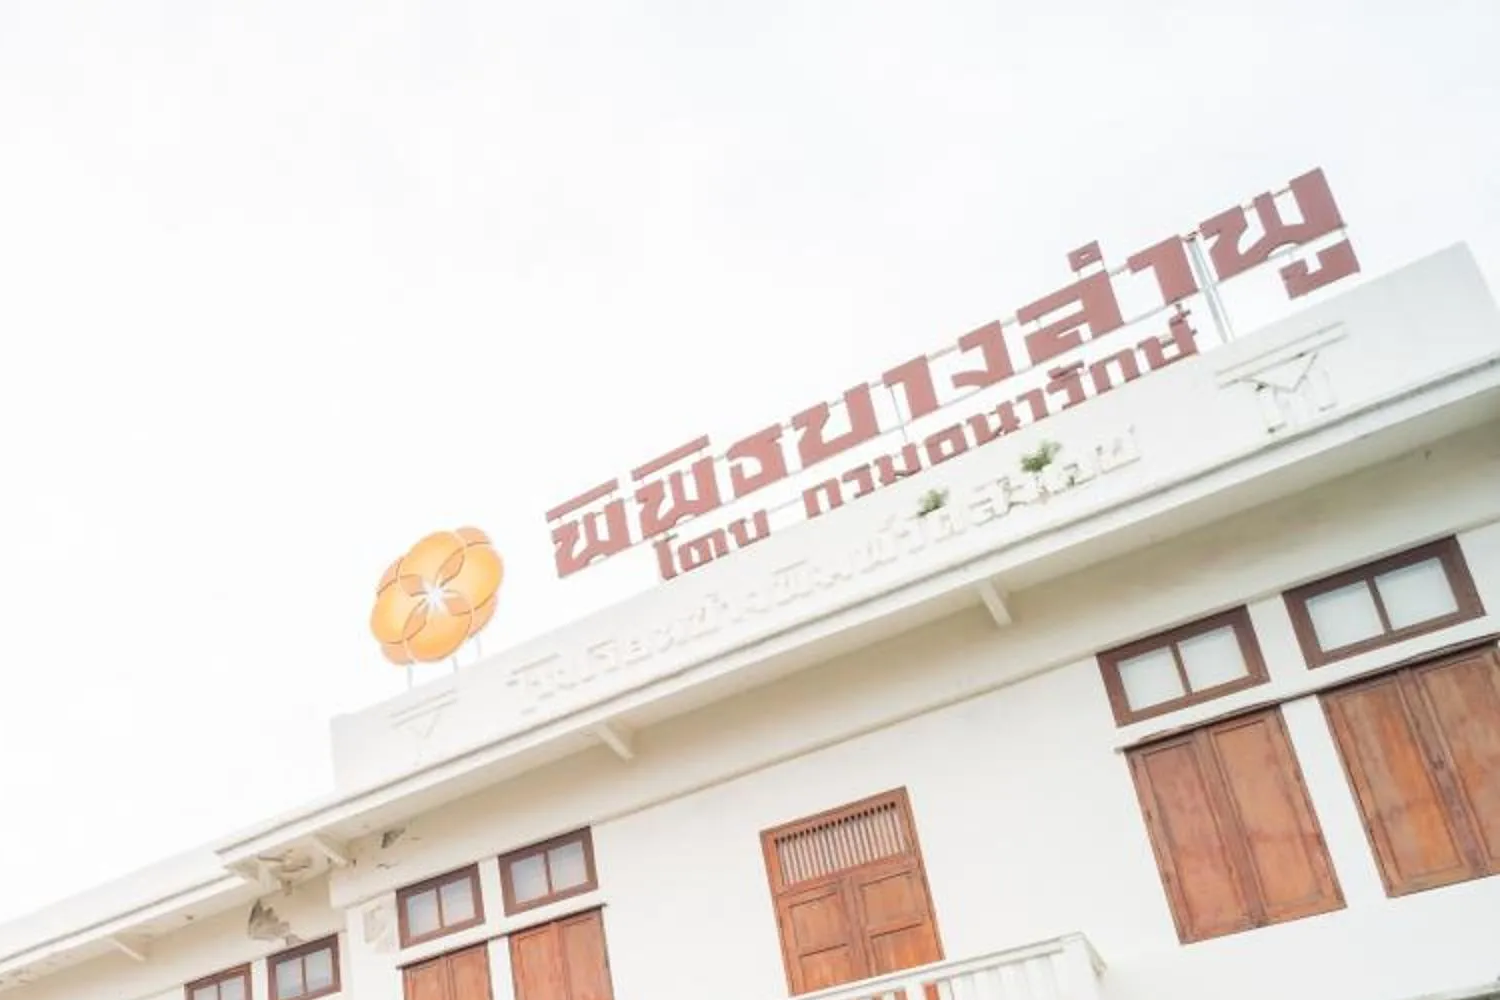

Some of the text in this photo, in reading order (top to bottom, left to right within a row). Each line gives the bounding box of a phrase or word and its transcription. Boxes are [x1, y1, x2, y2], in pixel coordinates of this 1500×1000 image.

[545, 167, 1361, 579] พิพิธบางลำพู
[653, 301, 1199, 581] โดย กรมธนารักษ์
